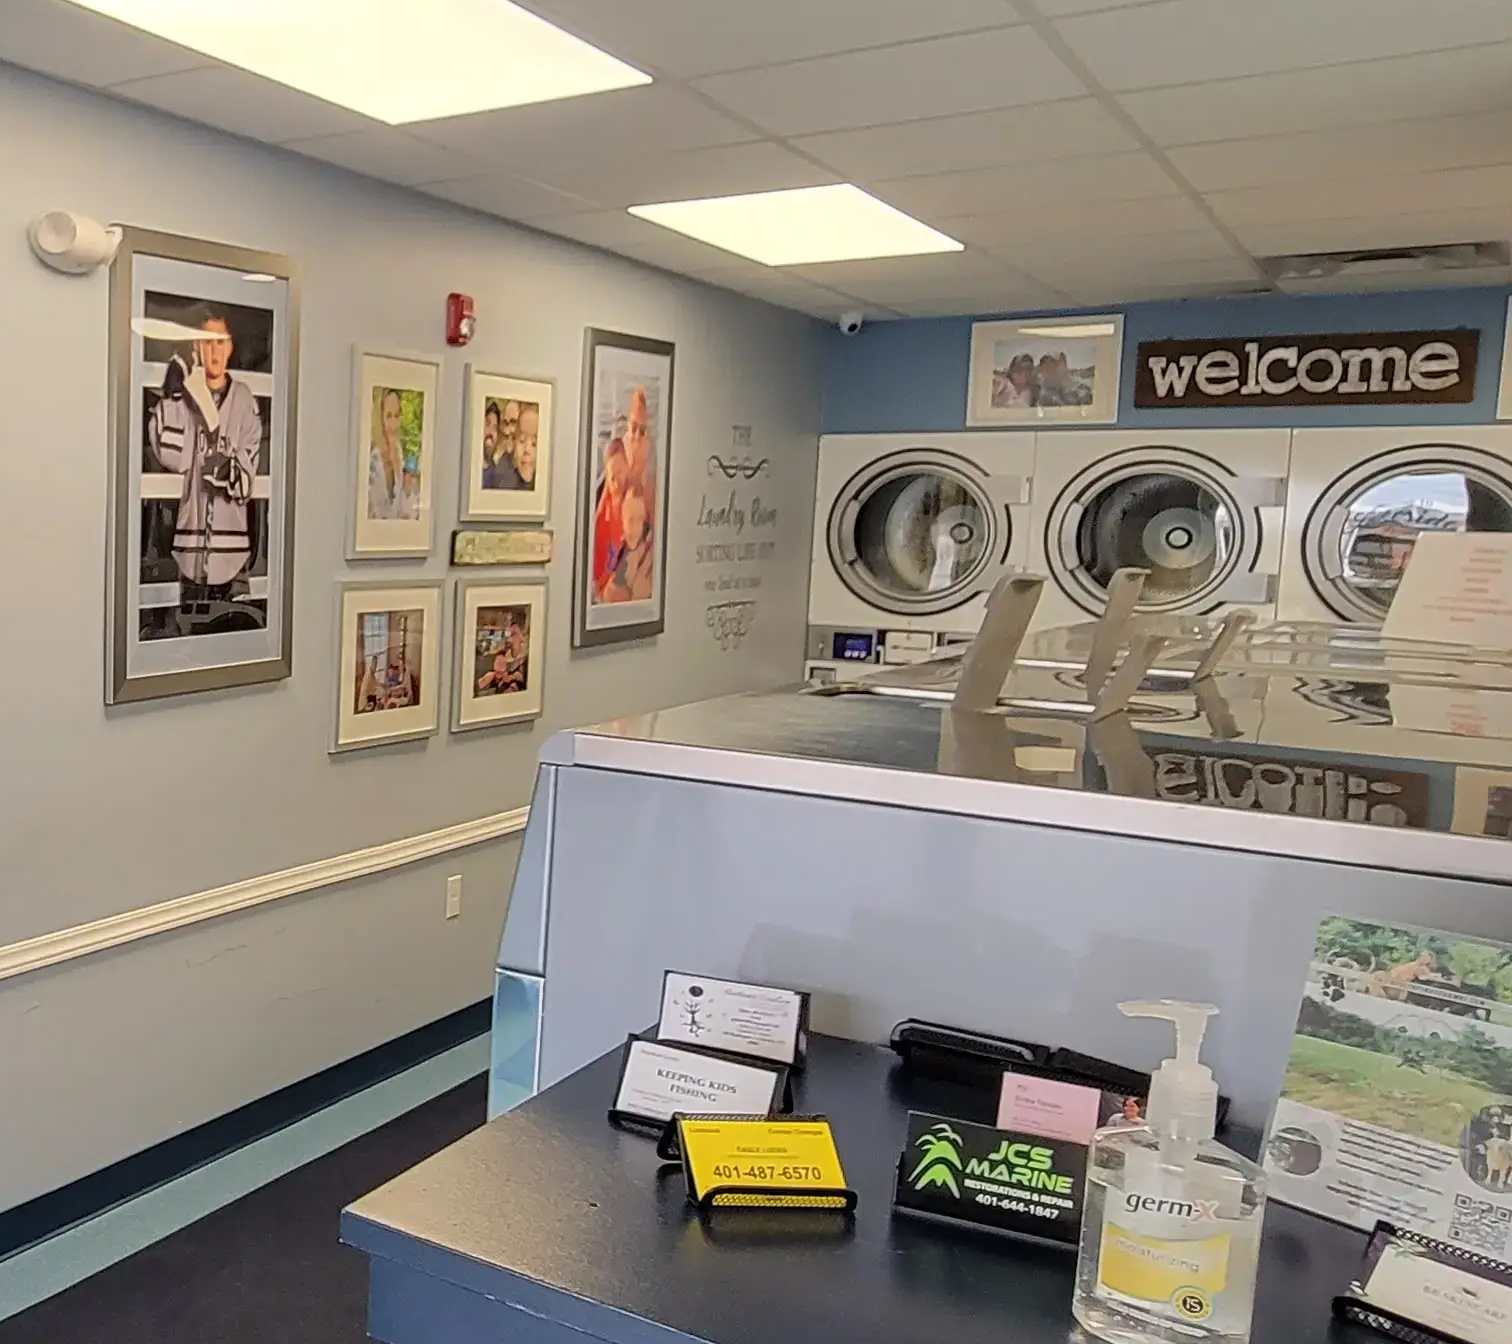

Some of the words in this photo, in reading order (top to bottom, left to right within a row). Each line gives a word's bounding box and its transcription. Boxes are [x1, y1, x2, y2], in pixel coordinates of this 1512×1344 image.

[1148, 341, 1461, 399] welcome
[657, 1068, 705, 1088] KEEPING
[708, 1080, 737, 1094] KIDS
[669, 1084, 718, 1102] FISHING
[988, 1140, 1054, 1170] JCS
[712, 1164, 821, 1181] 401-487-6570
[965, 1157, 1075, 1194] MARINE
[963, 1178, 1031, 1201] RESTORATIONS
[1031, 1190, 1040, 1202] &
[1039, 1192, 1075, 1210] REPAIR
[974, 1193, 1060, 1220] 401-644-1847
